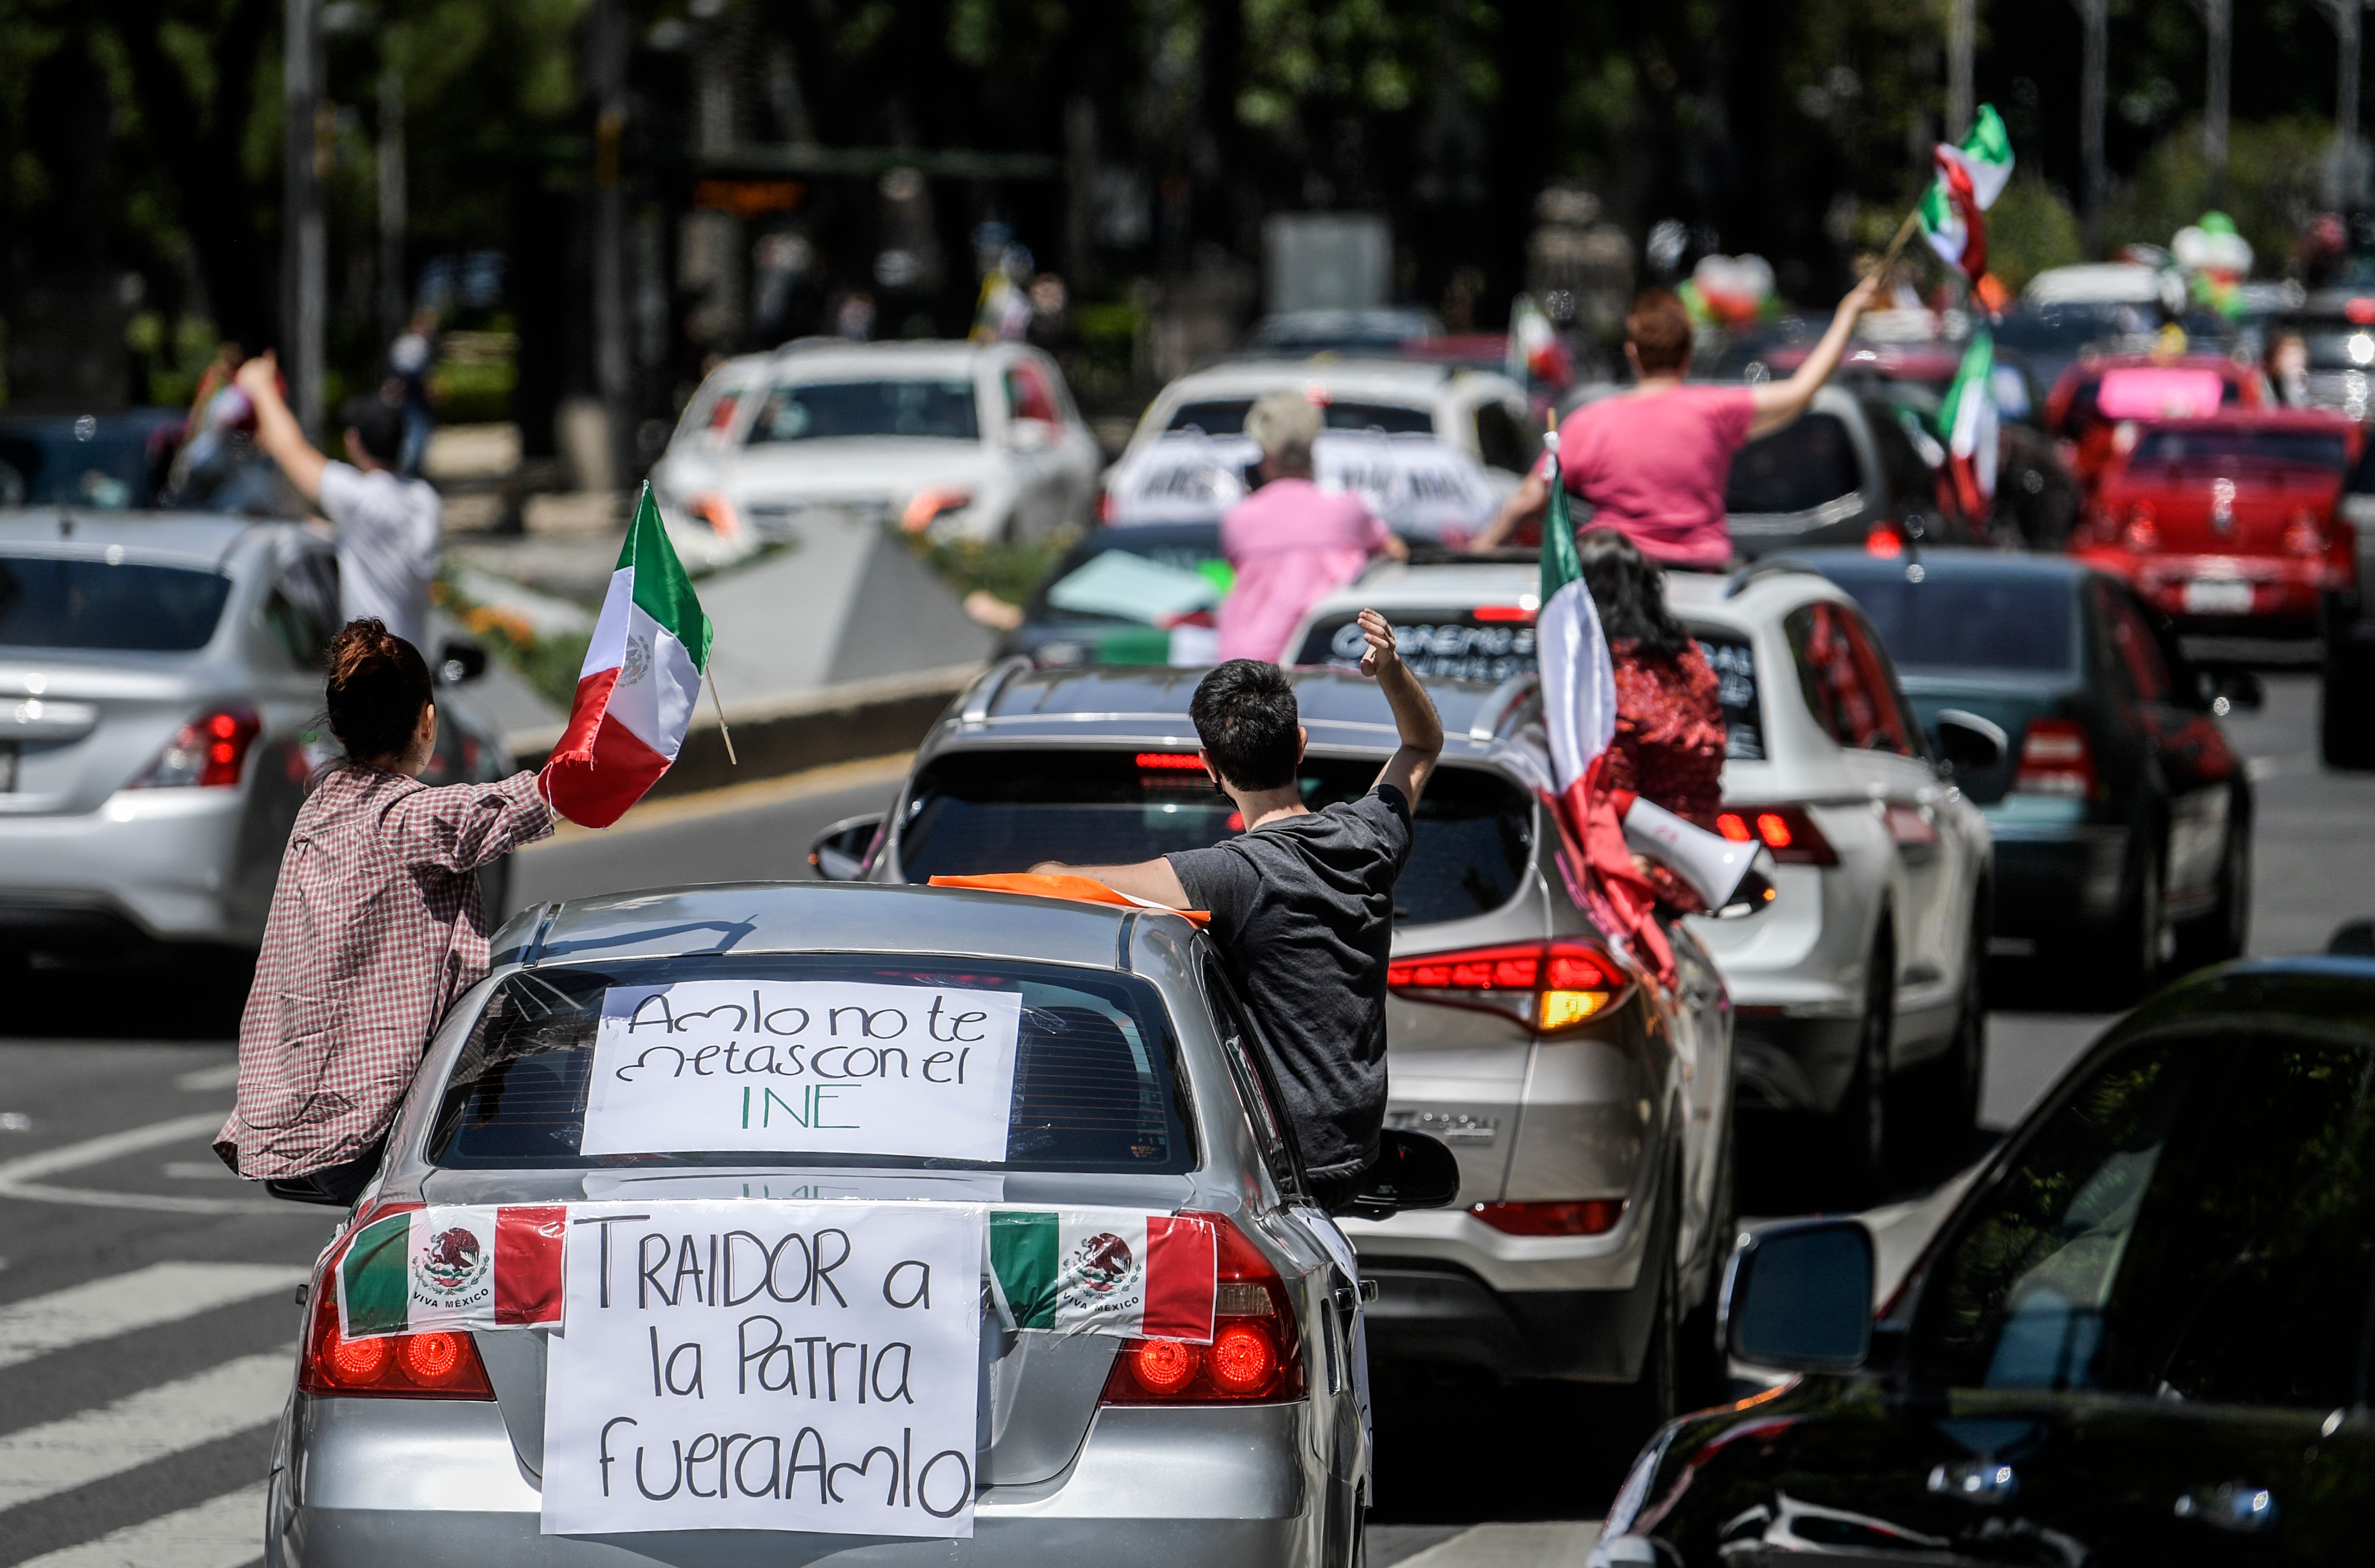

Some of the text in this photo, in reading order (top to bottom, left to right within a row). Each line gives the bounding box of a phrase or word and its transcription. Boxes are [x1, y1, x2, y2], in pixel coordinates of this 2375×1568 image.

[627, 990, 988, 1042] Amlo no te
[921, 1047, 971, 1085] el
[742, 1083, 862, 1129] INE
[573, 1214, 931, 1310] TRAIDOR a
[413, 1288, 489, 1309] VIVA MÉXICO
[1062, 1292, 1140, 1312] VIVA MÉXICO
[649, 1325, 705, 1400] la
